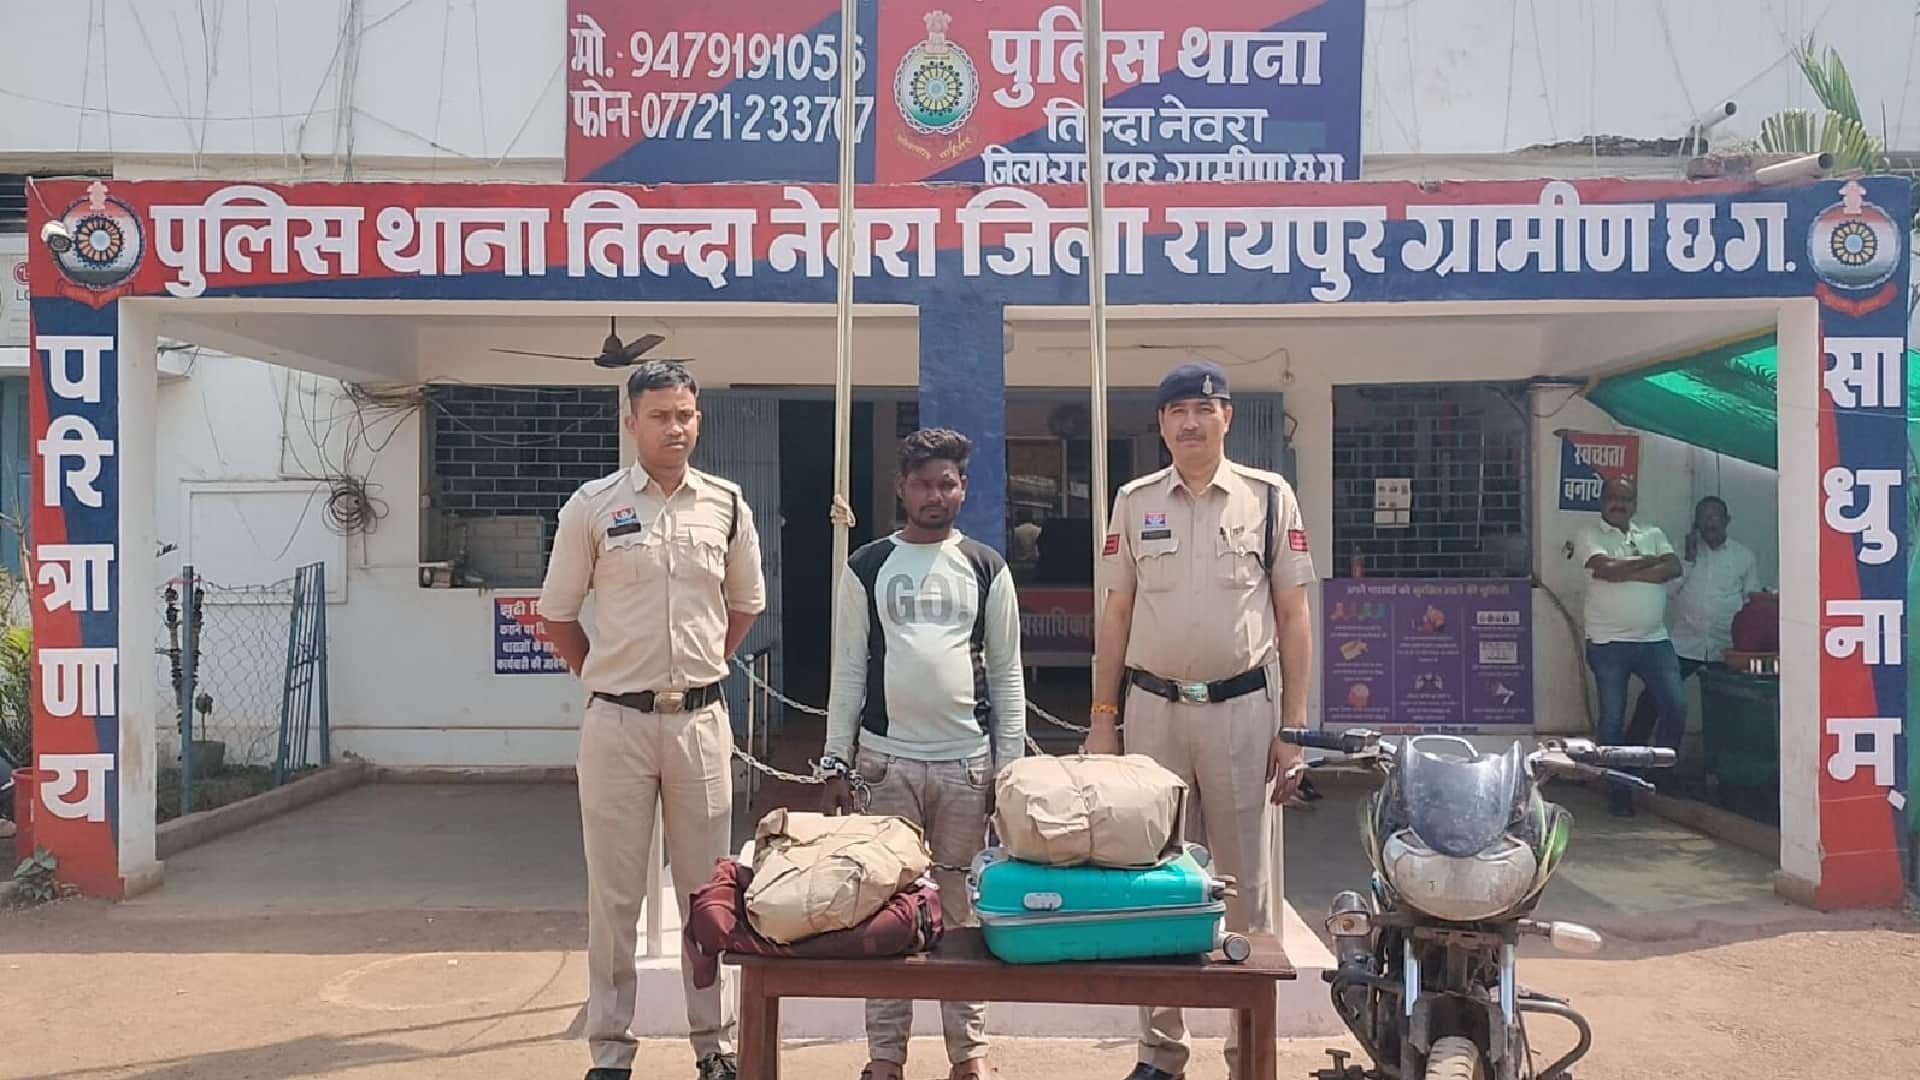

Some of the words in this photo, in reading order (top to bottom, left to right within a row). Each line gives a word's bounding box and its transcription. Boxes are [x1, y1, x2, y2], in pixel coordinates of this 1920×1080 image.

[988, 5, 1164, 108] पुलिस
[1177, 27, 1327, 84] थाना
[1159, 94, 1269, 144] नेवरा
[980, 144, 1049, 184] जिला
[149, 184, 365, 298] पुलिस
[376, 206, 549, 277] थाना
[563, 189, 757, 289] तिल्दा
[768, 186, 941, 278] नेवरा
[955, 186, 1149, 277] जिला
[1164, 206, 1387, 302] रायपुर
[1401, 181, 1655, 277] ग्रामीण
[1665, 202, 1797, 273] छ.ग.
[1573, 443, 1626, 468] स्वच्छता
